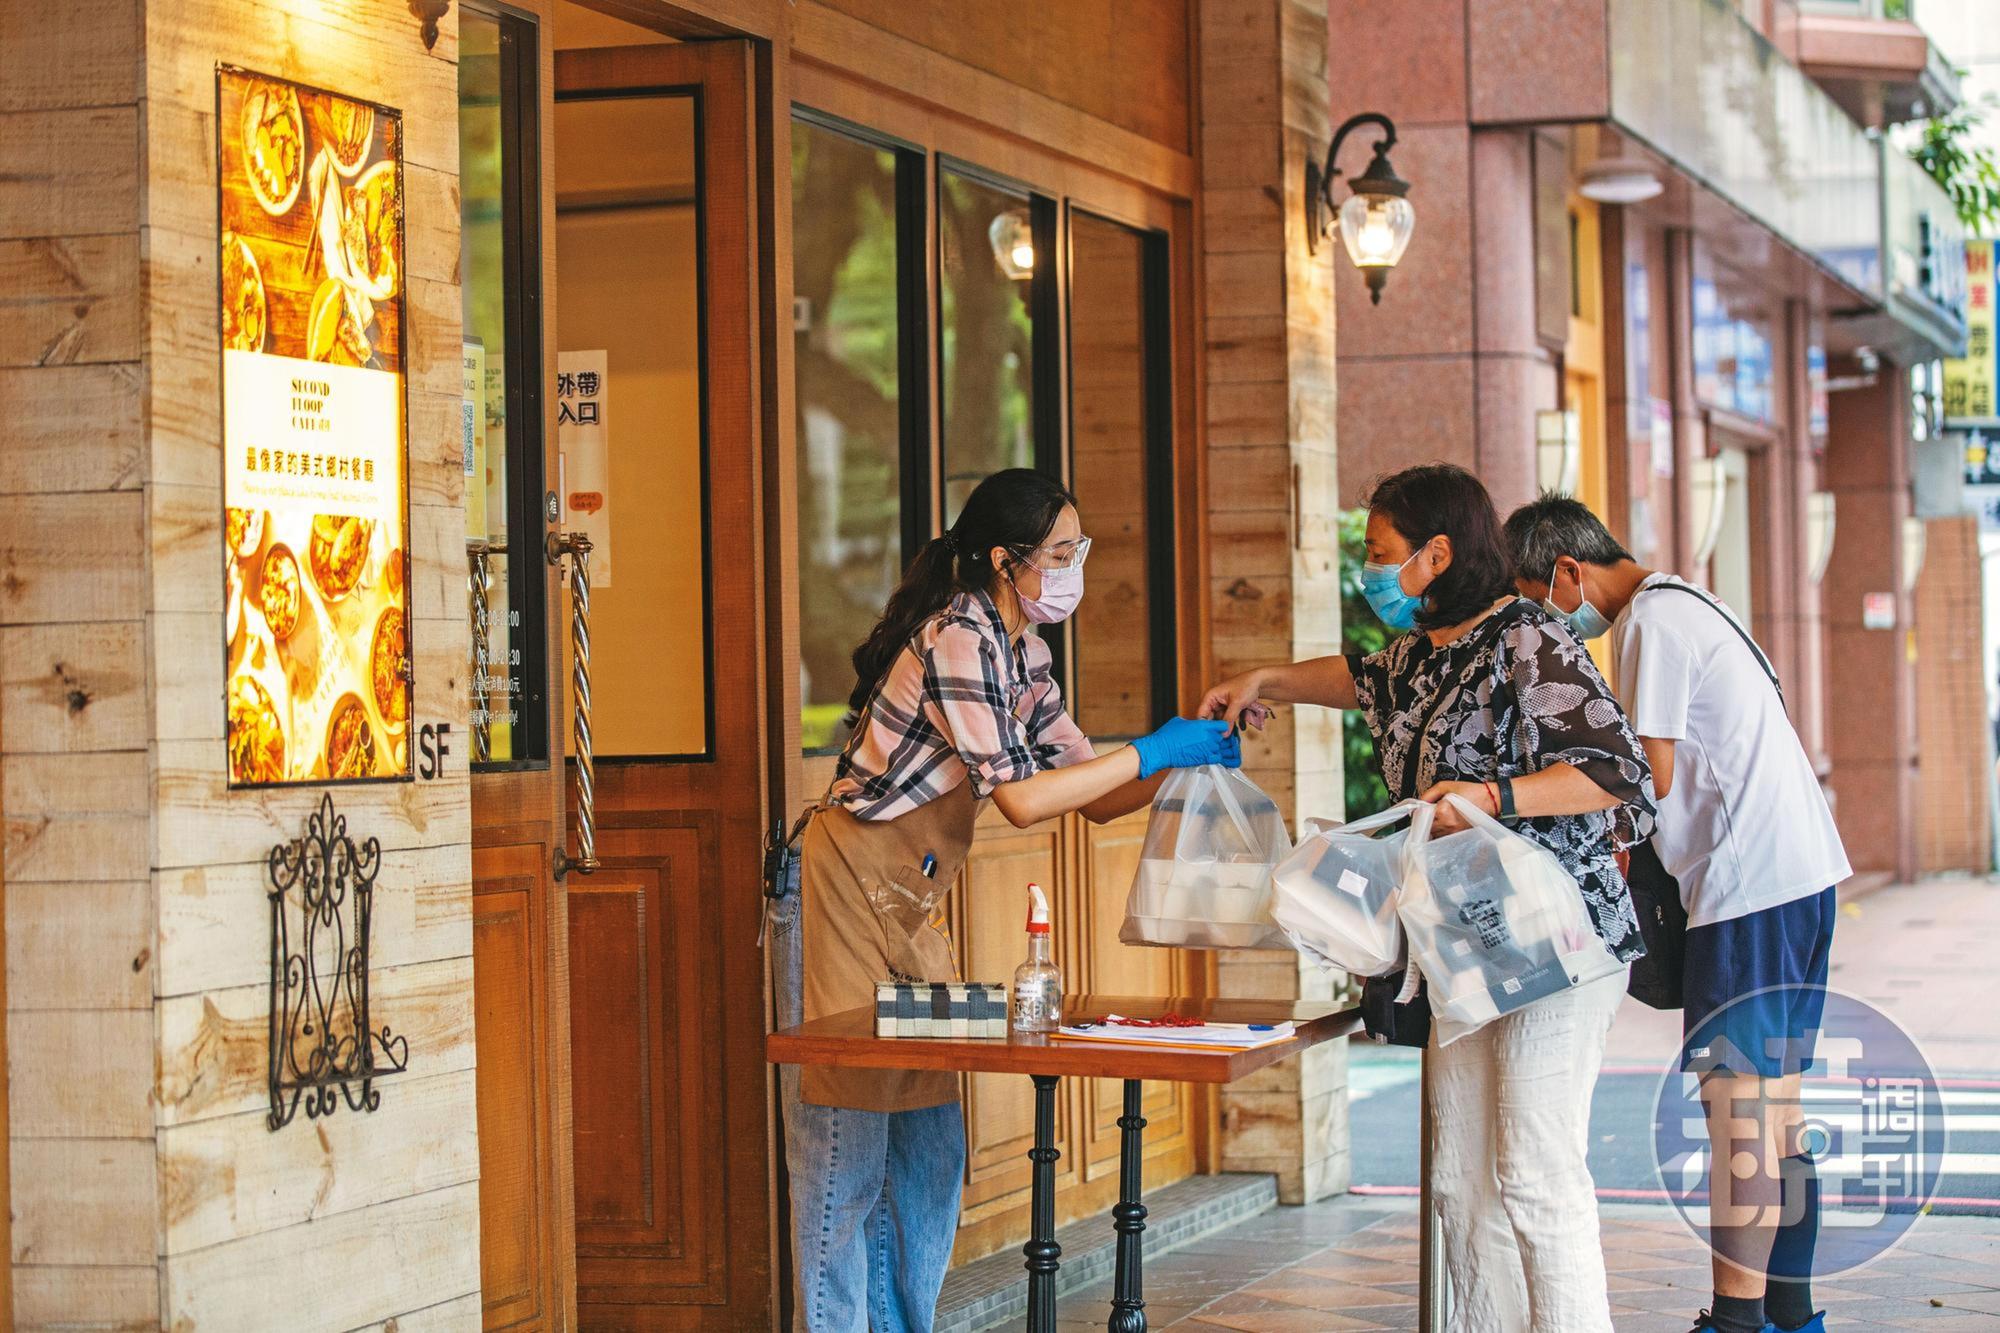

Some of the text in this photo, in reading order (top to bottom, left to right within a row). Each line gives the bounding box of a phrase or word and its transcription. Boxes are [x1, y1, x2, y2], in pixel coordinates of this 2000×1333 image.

[557, 371, 599, 396] 外帶
[557, 401, 599, 425] 入口
[419, 722, 451, 780] SF
